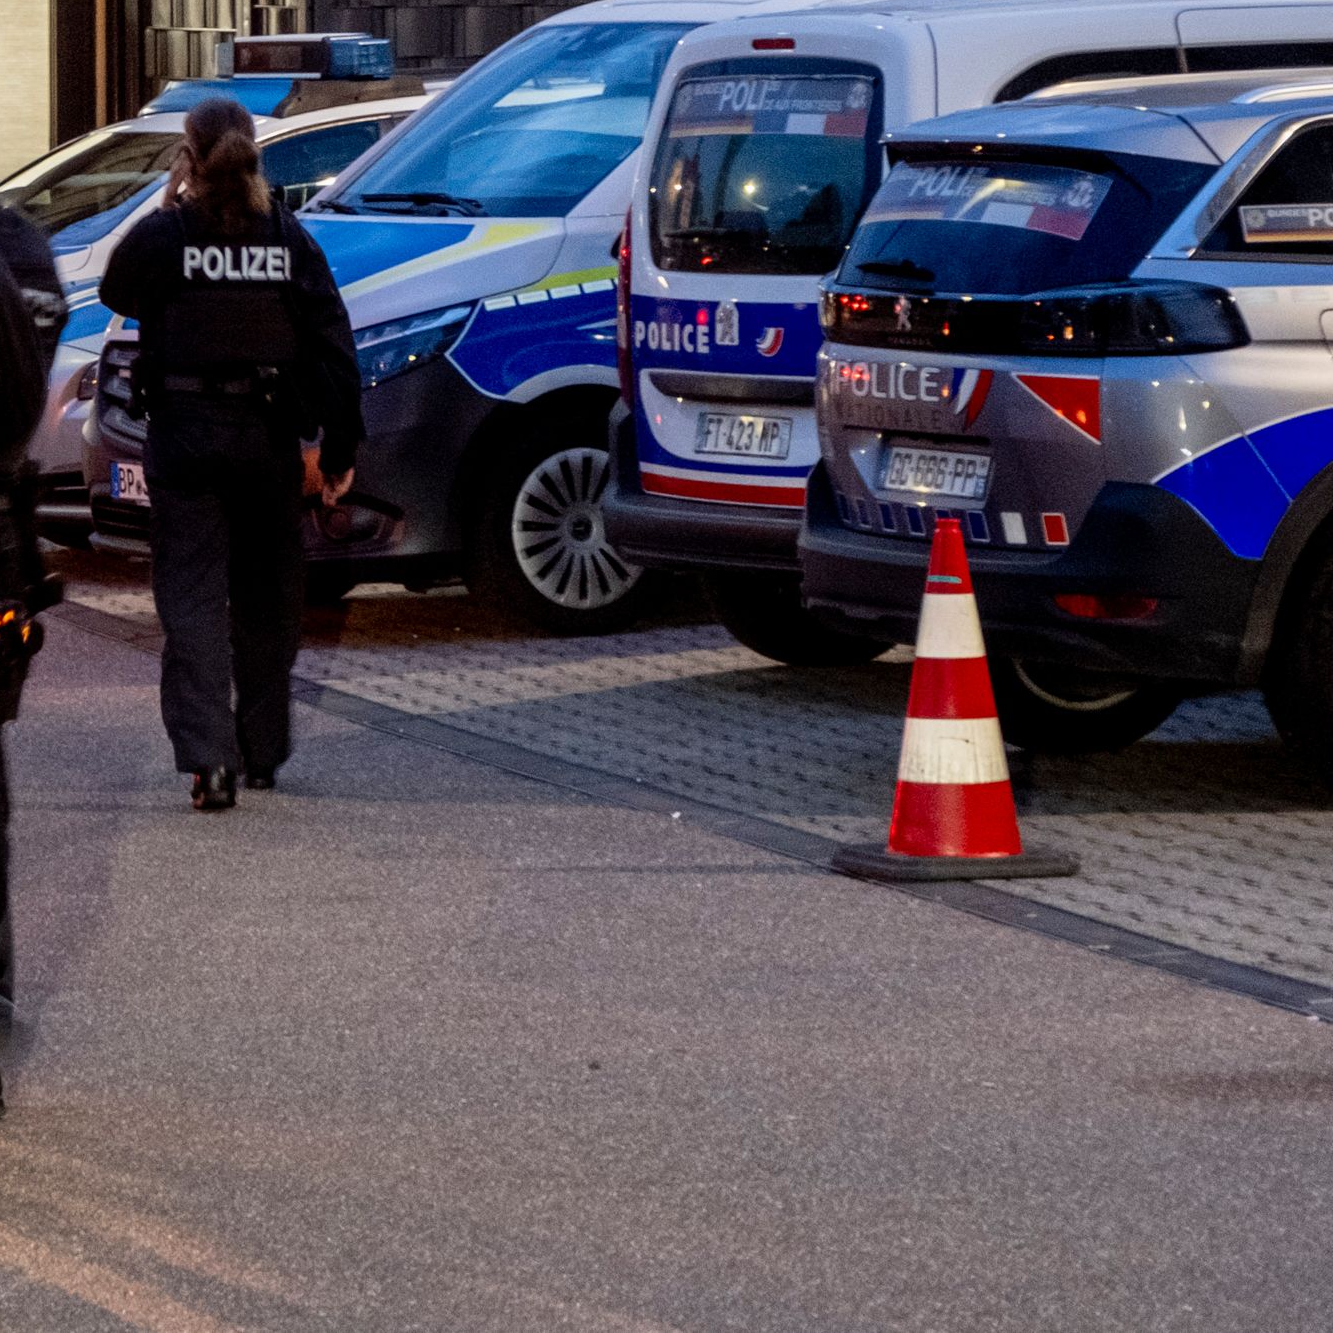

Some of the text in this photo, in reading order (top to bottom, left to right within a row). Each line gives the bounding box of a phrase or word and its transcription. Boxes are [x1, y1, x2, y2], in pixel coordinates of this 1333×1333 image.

[183, 245, 291, 282] POLIZEI
[633, 319, 711, 354] POLICE
[834, 360, 942, 403] POLICE
[119, 467, 134, 494] BP
